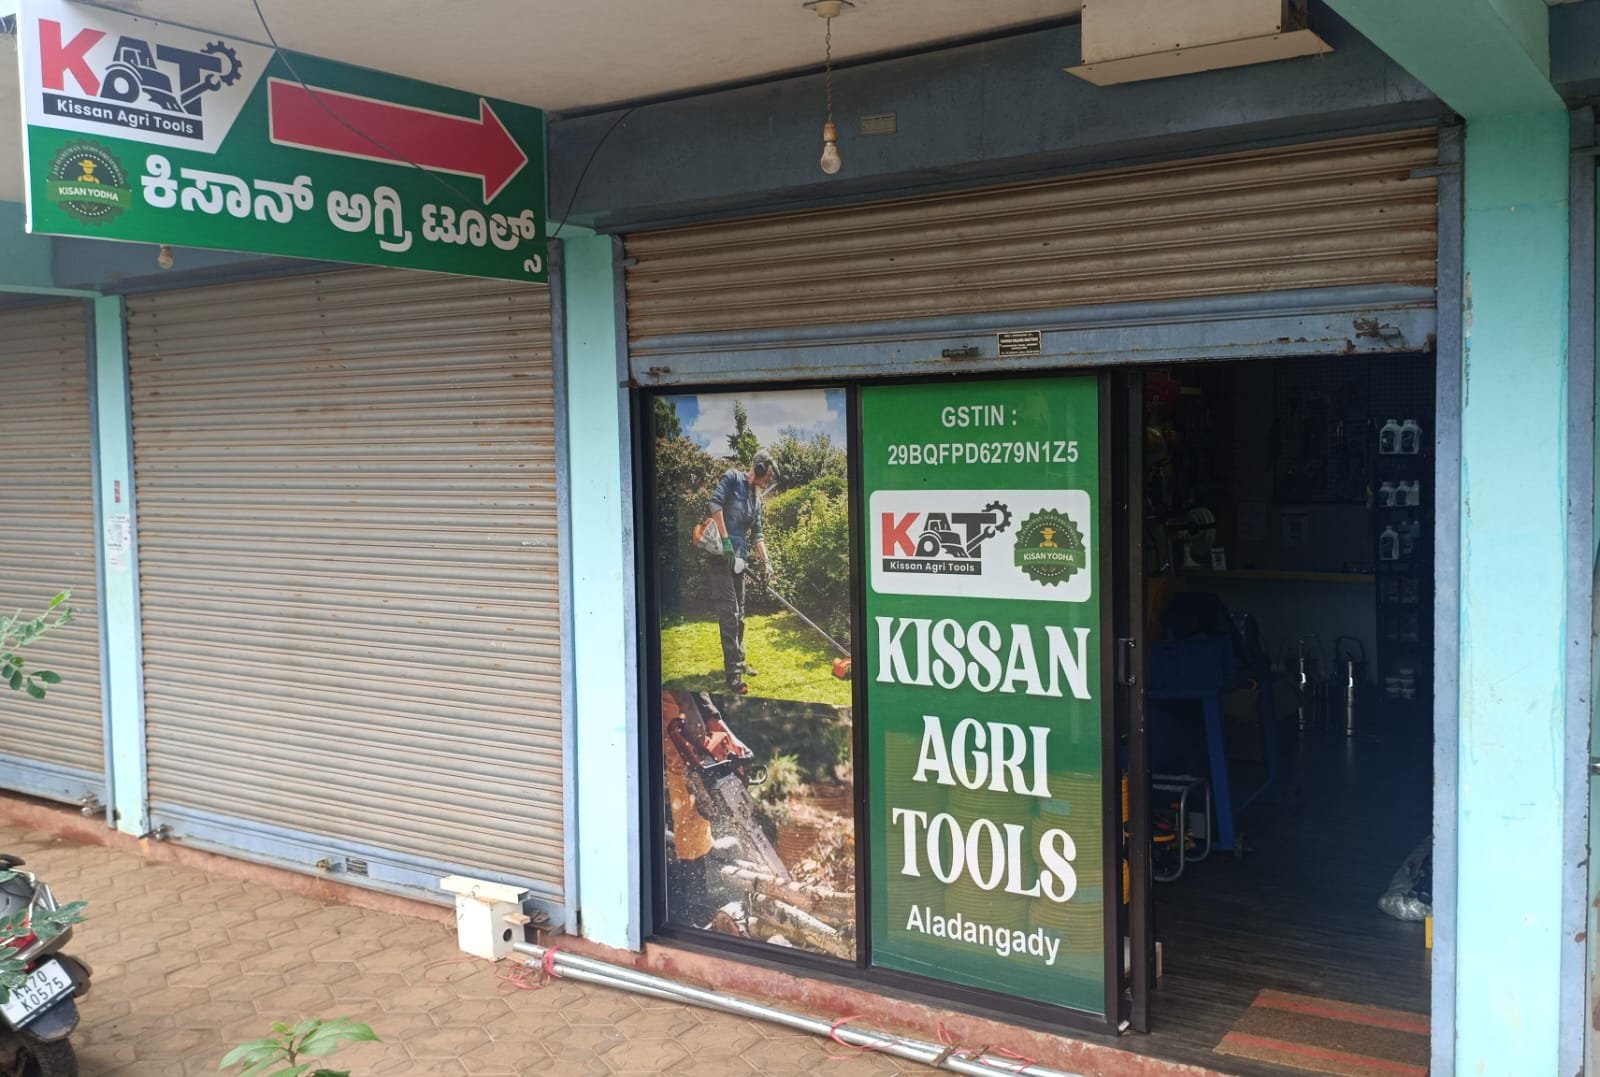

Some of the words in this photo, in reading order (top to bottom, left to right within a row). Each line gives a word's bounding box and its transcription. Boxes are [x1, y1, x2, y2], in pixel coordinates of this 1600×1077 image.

[57, 99, 113, 120] Kissan
[117, 110, 150, 128] Agri
[153, 116, 194, 135] Tools
[58, 186, 87, 196] KISAN
[87, 188, 120, 202] YODHA
[141, 154, 314, 224] ಕಿಸಾನ್
[327, 186, 413, 253] ಅಗ್ರಿ
[941, 405, 1005, 427] GSTIN
[887, 441, 1079, 466] 29BQFPD6279N1Z5
[890, 561, 922, 571] Kissan
[925, 562, 946, 573] Agri
[948, 563, 975, 572] Tools
[1023, 553, 1046, 561] KISAN
[1046, 552, 1075, 562] YODHA
[875, 616, 1092, 700] KISSAN
[912, 715, 1052, 798] AGRI
[892, 807, 1078, 903] TOOLS
[906, 904, 1061, 966] Aladangady
[21, 977, 65, 1012] K0575
